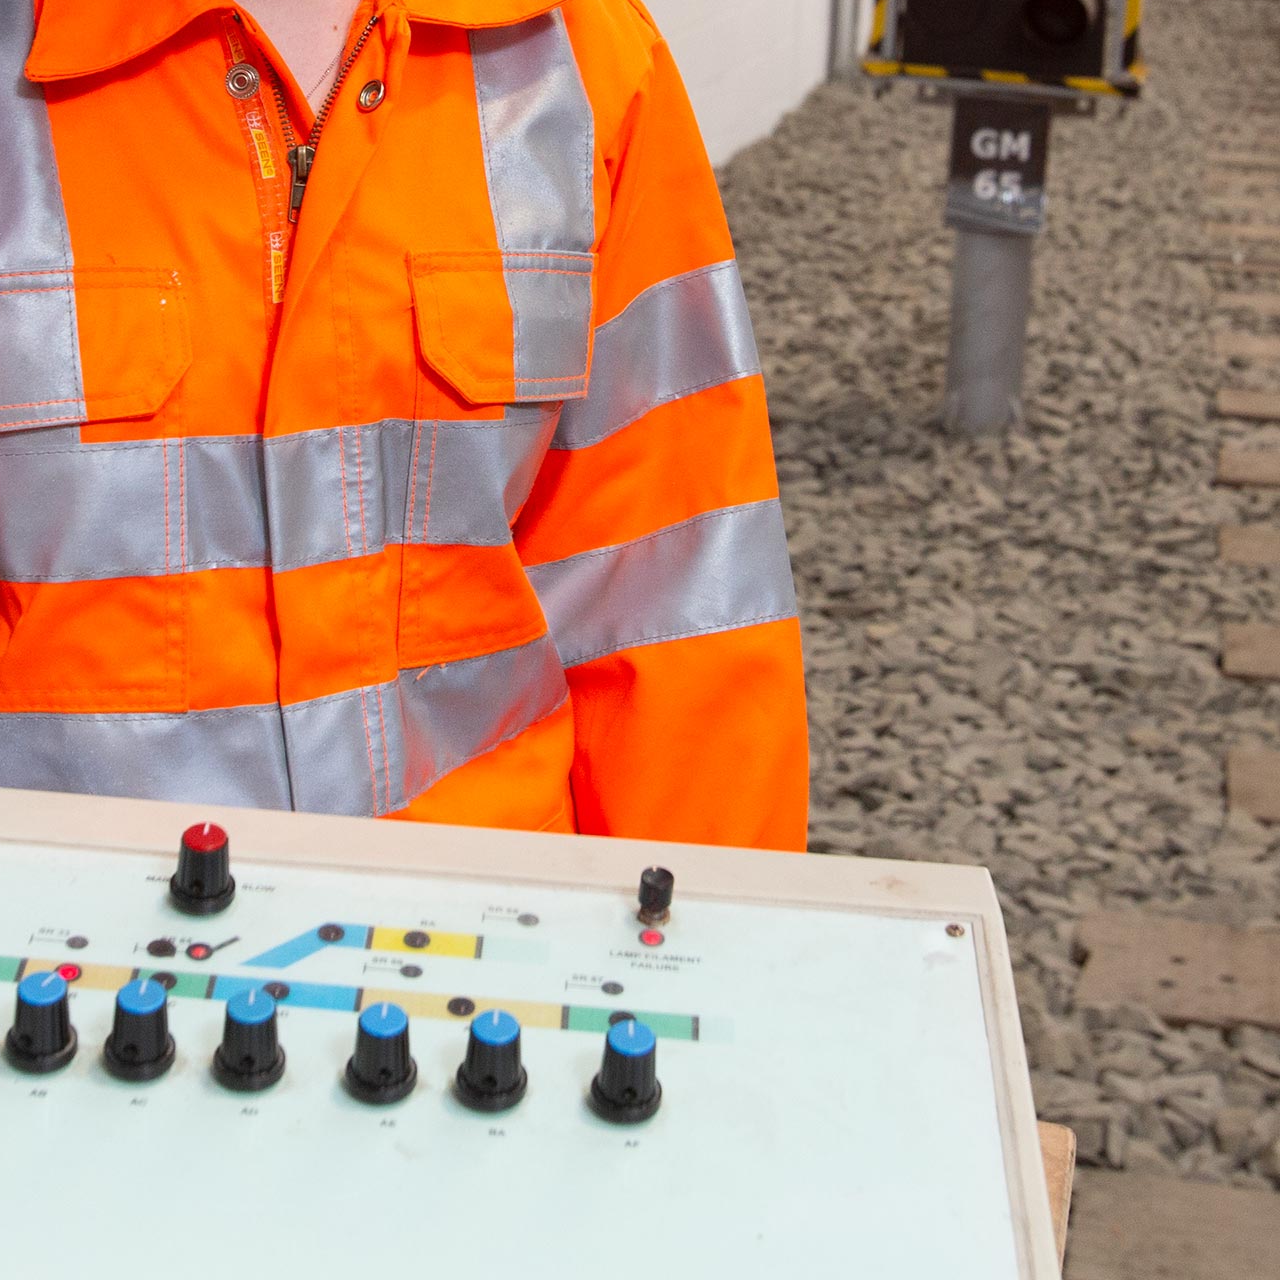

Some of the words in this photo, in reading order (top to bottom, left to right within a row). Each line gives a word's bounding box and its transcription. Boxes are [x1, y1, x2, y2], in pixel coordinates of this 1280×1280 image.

[970, 129, 1031, 161] GM
[973, 170, 1024, 202] 65
[630, 961, 679, 972] FAILURE
